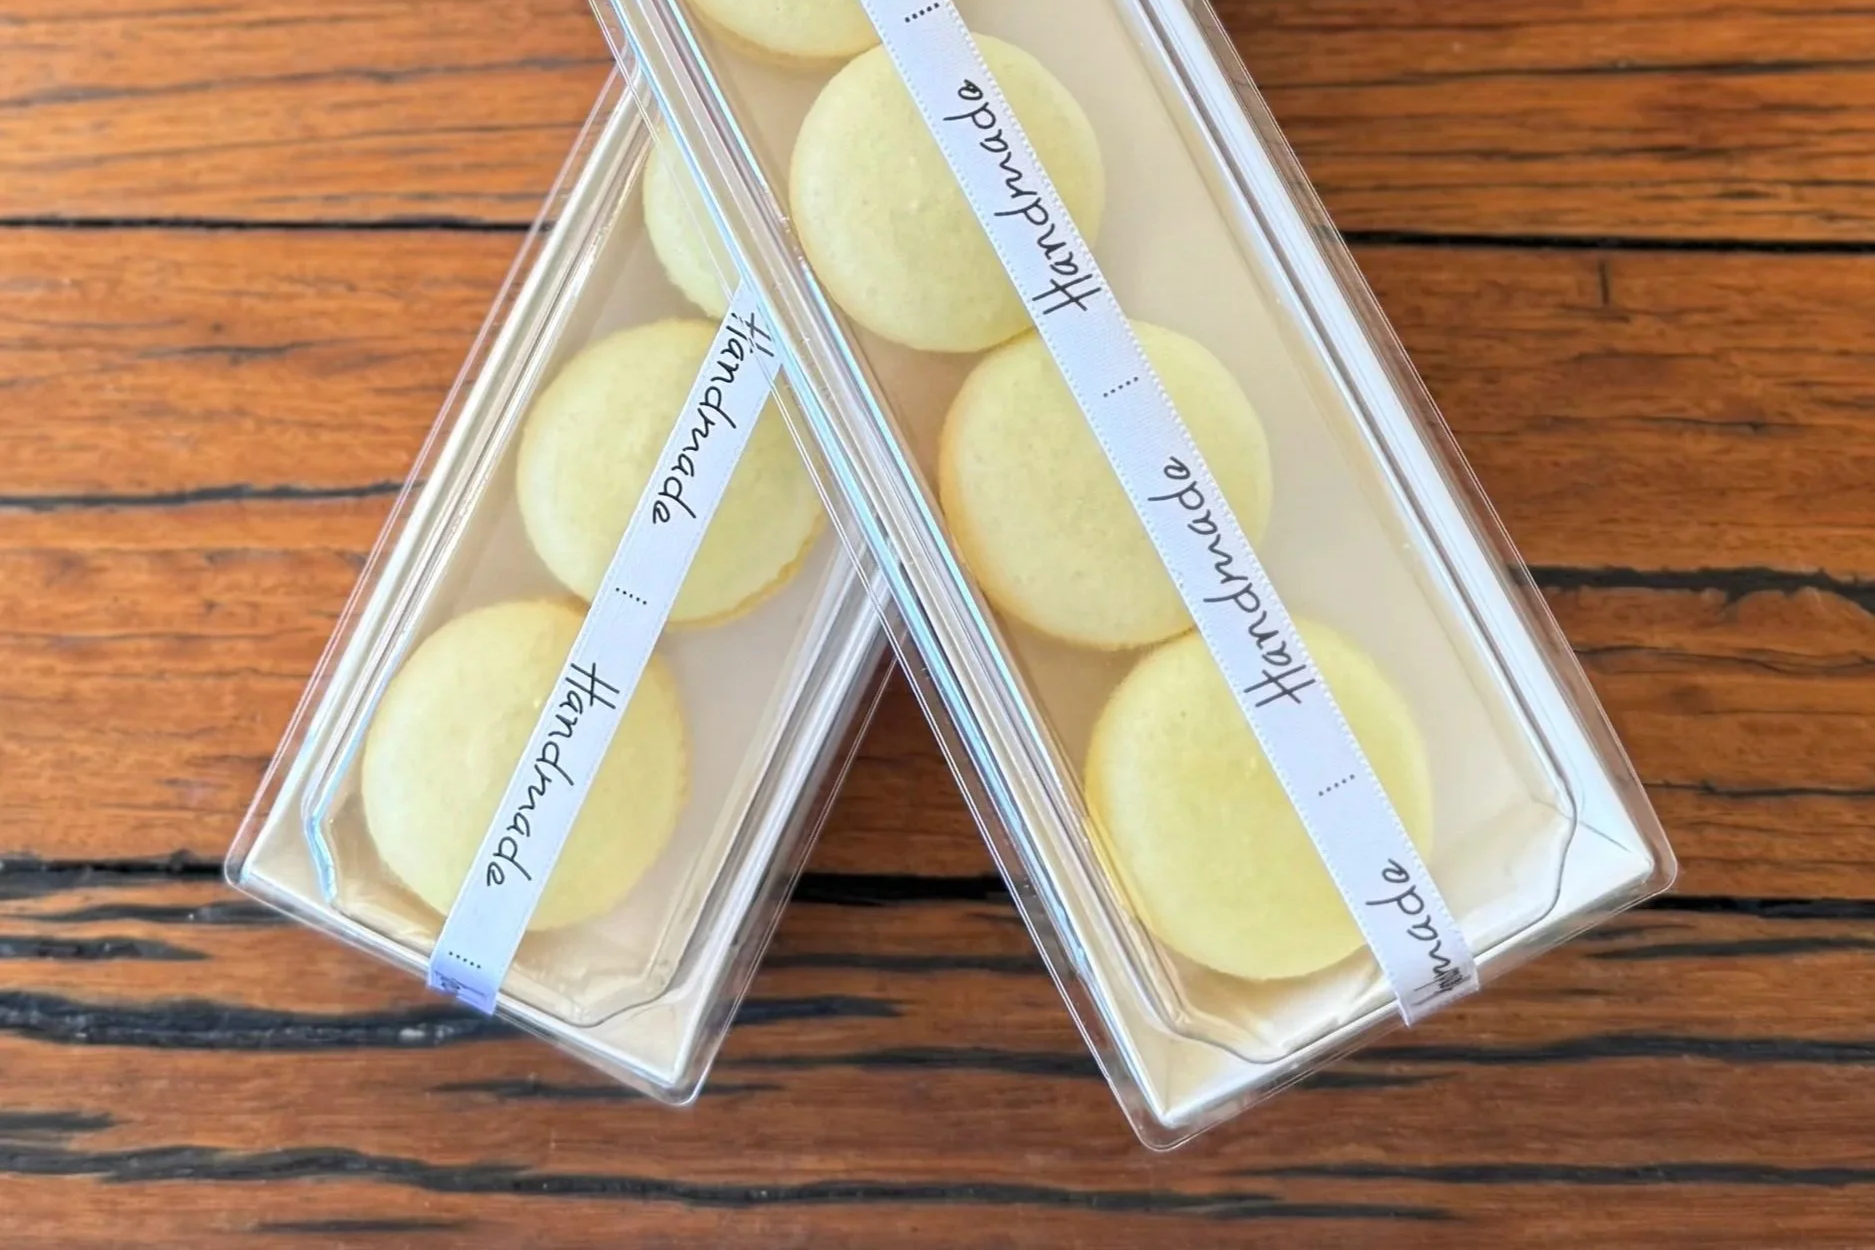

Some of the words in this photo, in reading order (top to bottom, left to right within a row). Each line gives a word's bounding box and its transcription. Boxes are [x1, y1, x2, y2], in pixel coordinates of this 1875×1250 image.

[942, 78, 1102, 315] Handmade
[1147, 455, 1316, 708] Handmade
[486, 661, 621, 888] Handmade
